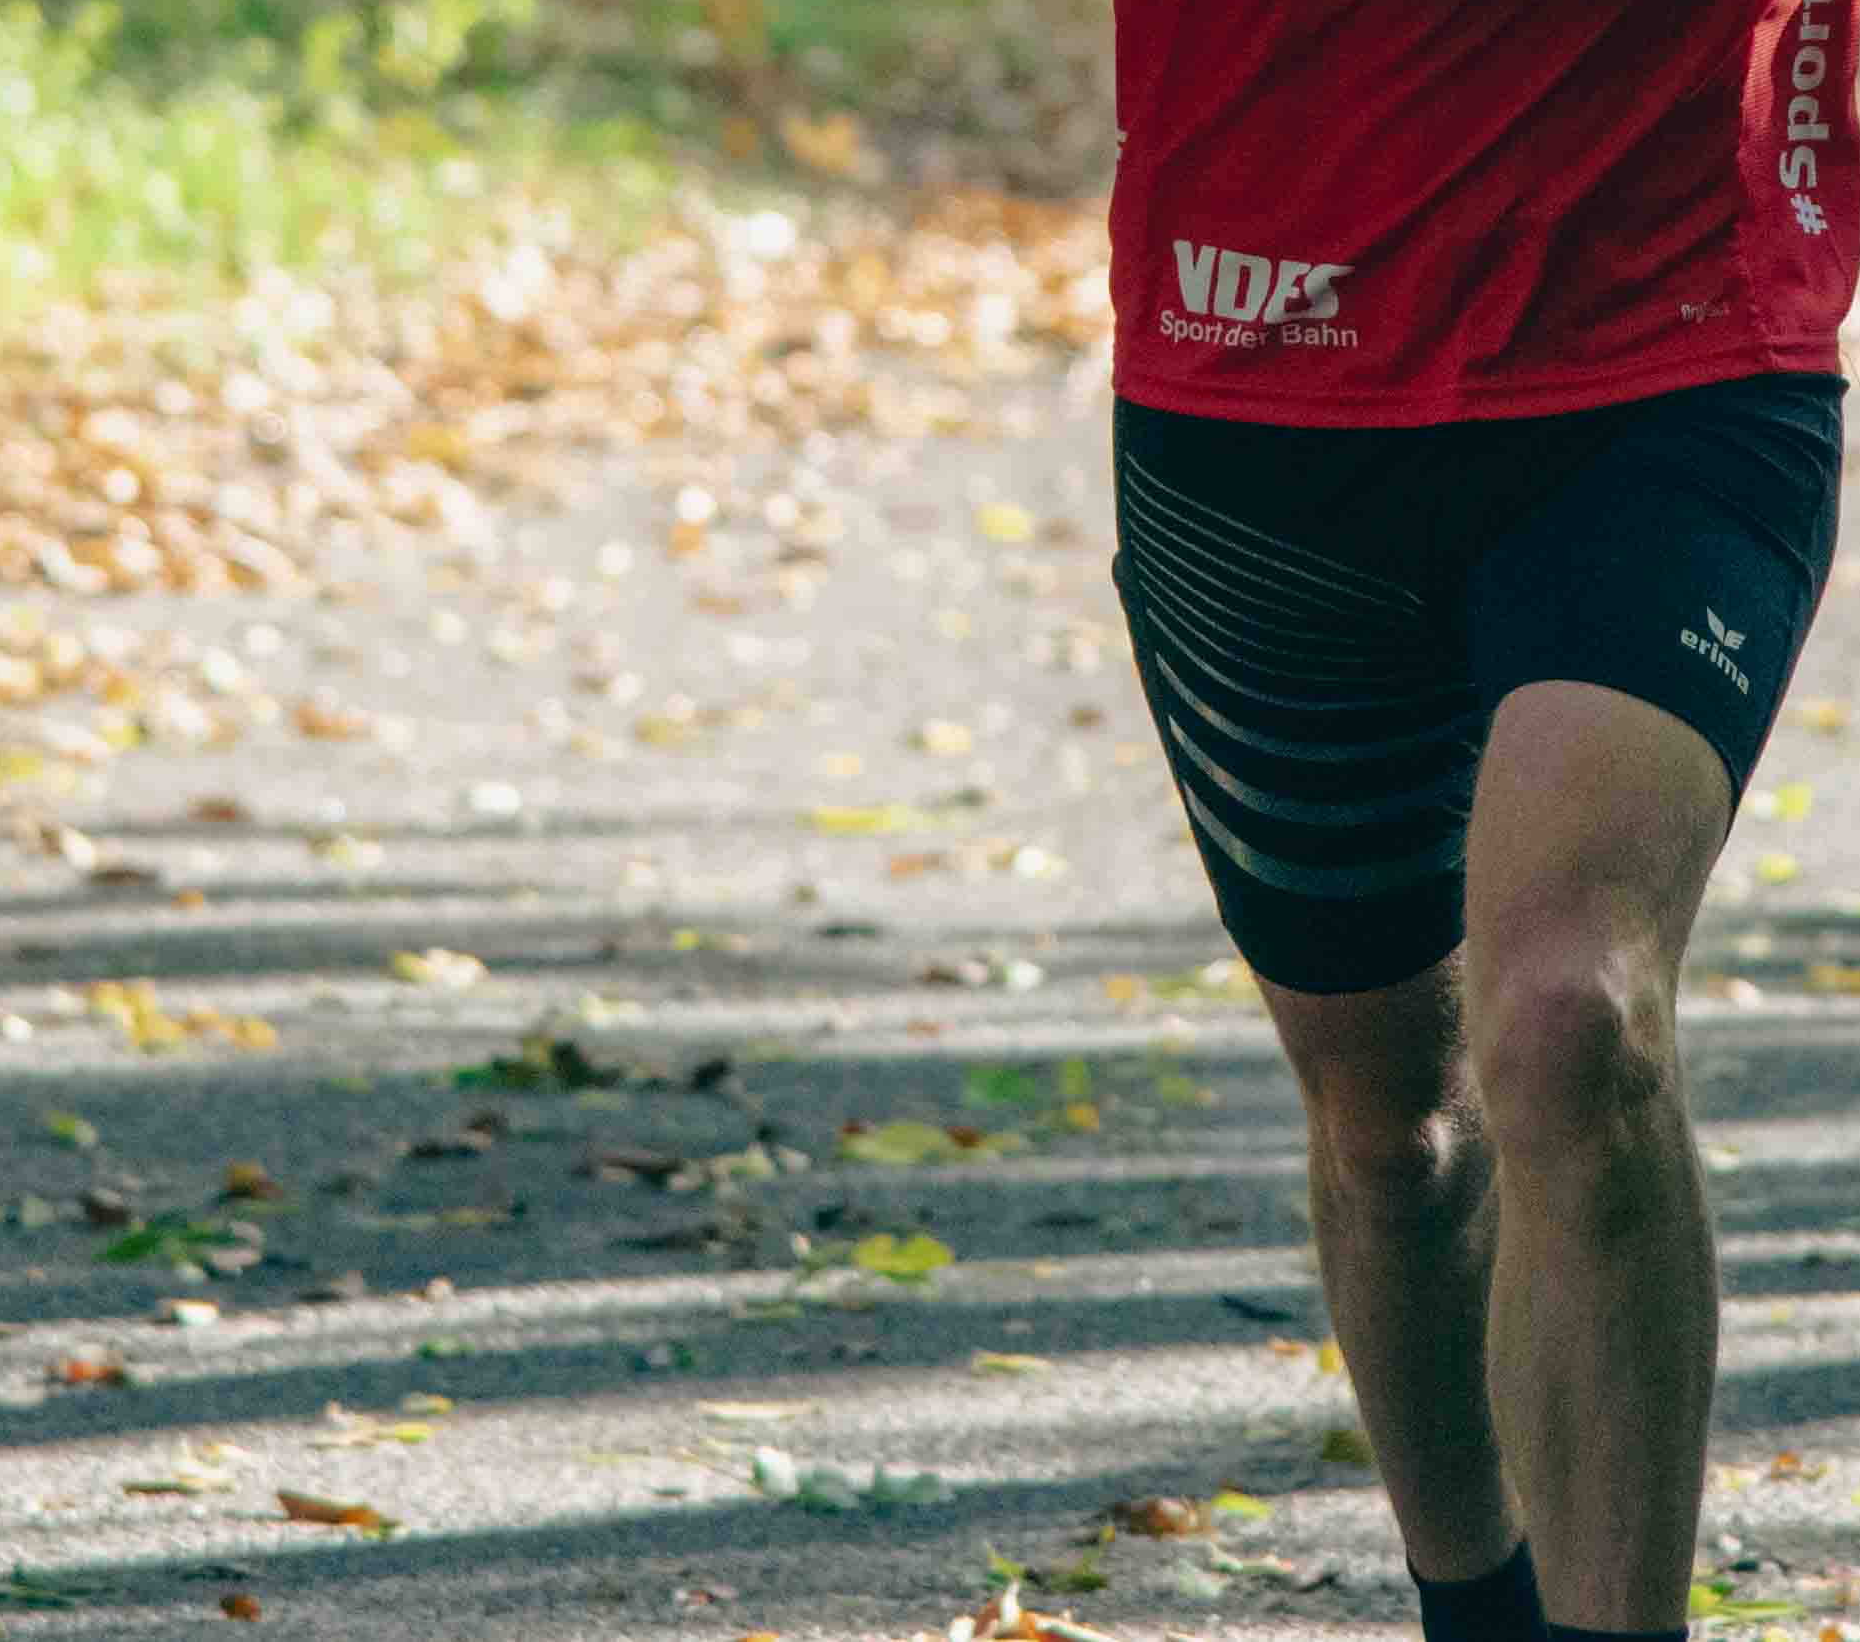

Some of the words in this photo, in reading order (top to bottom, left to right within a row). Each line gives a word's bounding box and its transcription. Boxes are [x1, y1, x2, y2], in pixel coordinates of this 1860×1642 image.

[1159, 309, 1223, 344] Sport
[1224, 323, 1269, 348] der
[1282, 323, 1358, 348] Bahn
[1680, 629, 1749, 695] erima
